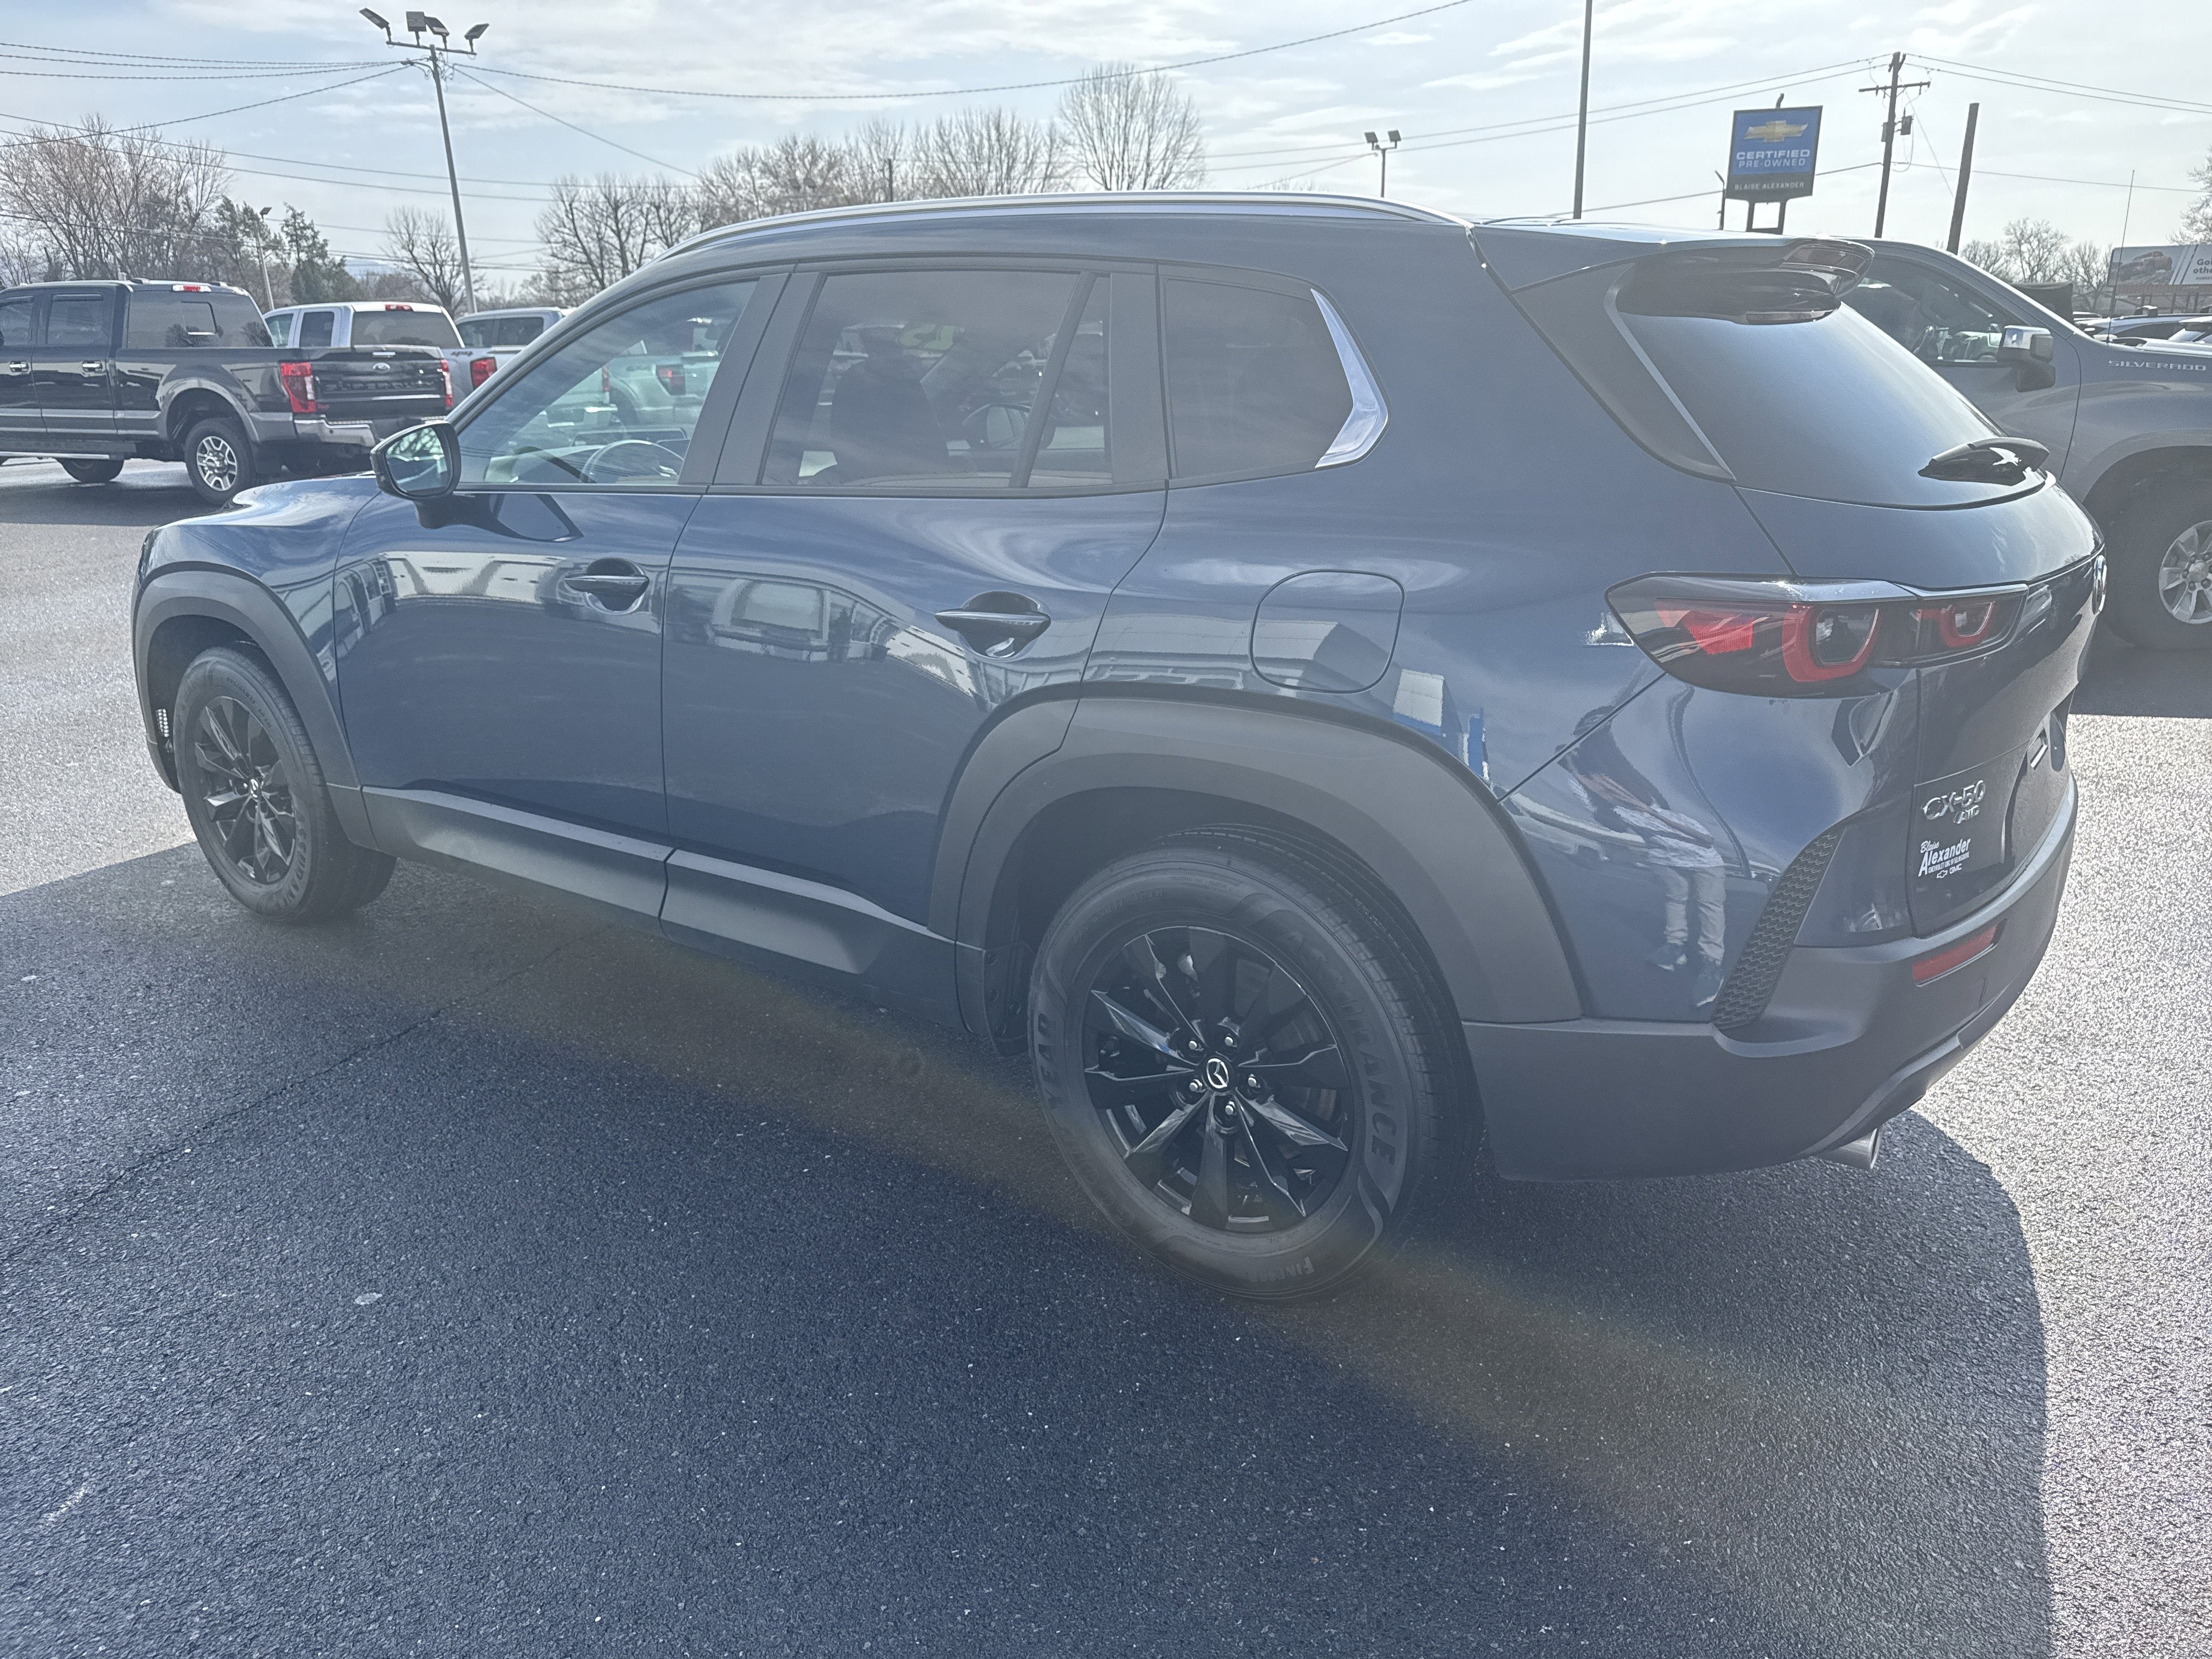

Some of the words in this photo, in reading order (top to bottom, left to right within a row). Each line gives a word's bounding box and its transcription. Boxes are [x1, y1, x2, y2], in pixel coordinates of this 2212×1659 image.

[1736, 149, 1810, 160] CERTIFIED
[1739, 158, 1805, 168] PRE-OWNED
[2108, 360, 2207, 371] SILVERADO
[1922, 780, 1986, 820] CX-50
[1920, 840, 1940, 854] Blaise
[1918, 838, 1971, 877] Alexander
[1949, 864, 1962, 874] GMC
